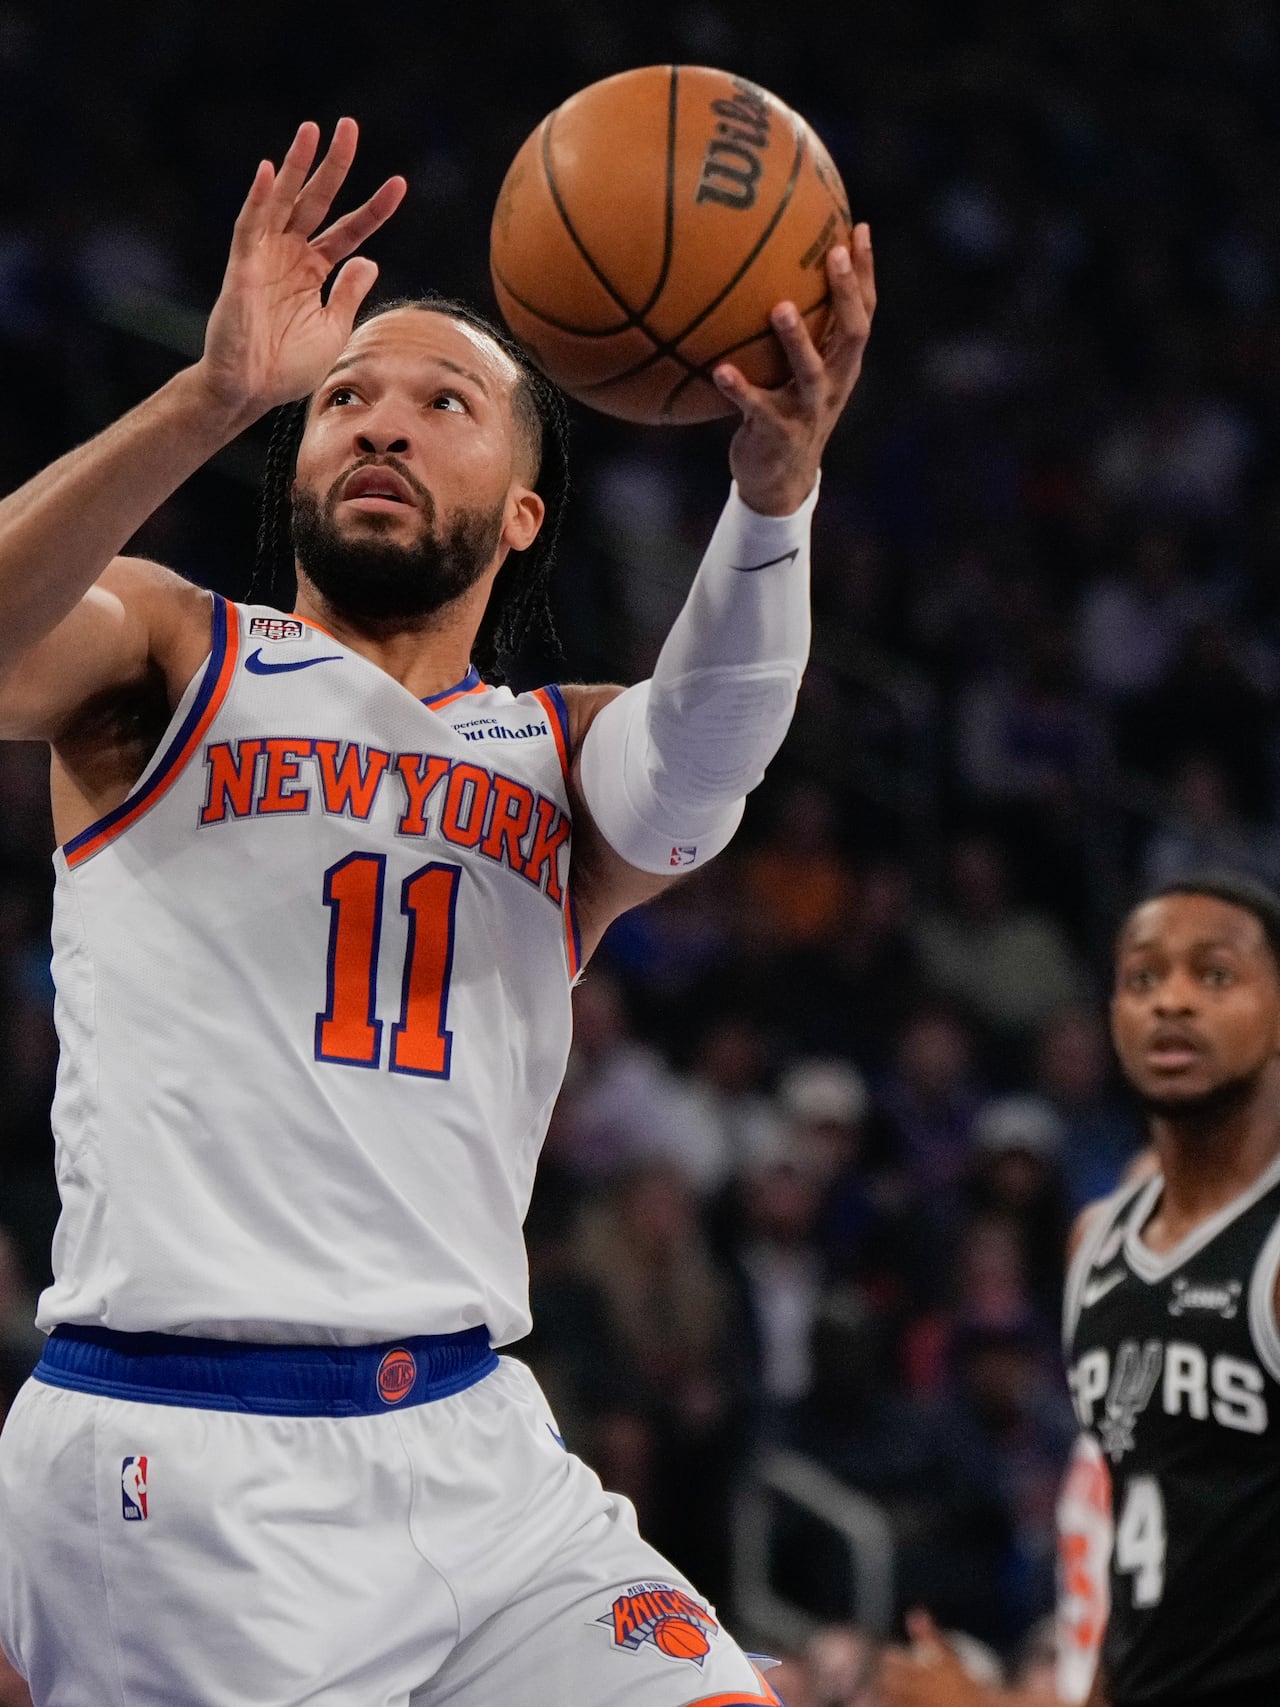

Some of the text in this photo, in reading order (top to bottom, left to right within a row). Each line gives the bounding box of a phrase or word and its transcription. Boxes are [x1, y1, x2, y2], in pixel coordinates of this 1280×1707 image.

[451, 718, 497, 731] perience
[488, 721, 548, 739] dhabi
[197, 735, 572, 908] NEW YORK
[314, 850, 462, 1080] 11
[1117, 1474, 1166, 1609] 4
[612, 1589, 718, 1650] KNICKS
[627, 1583, 646, 1597] NEW
